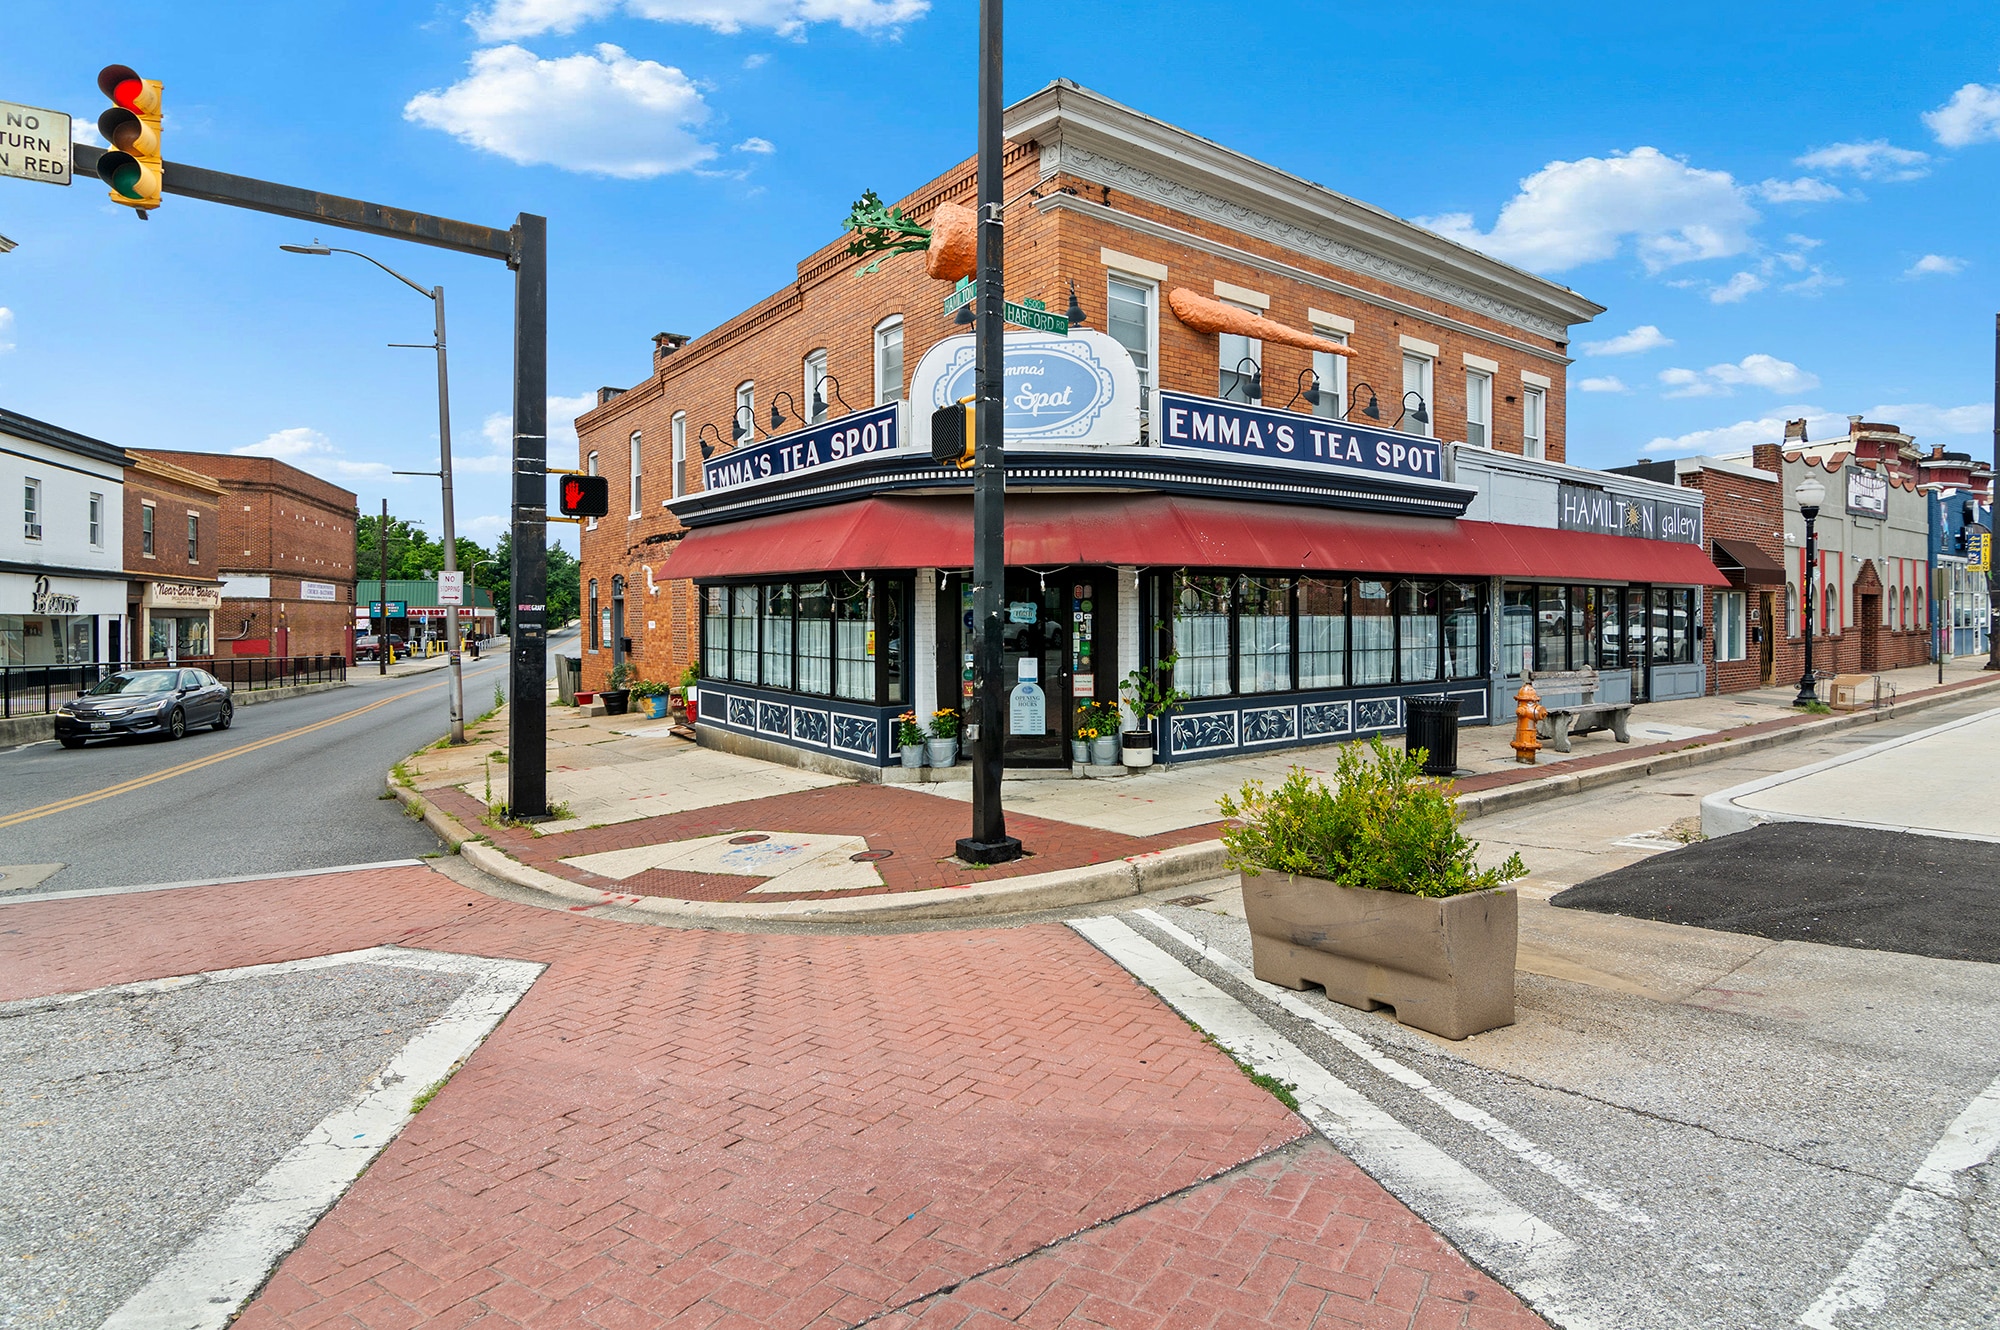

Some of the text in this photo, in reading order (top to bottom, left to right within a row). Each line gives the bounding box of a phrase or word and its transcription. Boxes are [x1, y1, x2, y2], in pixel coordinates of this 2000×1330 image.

[7, 111, 39, 130] NO
[0, 131, 50, 153] TURN
[0, 153, 63, 175] N RED
[944, 284, 975, 313] HAMILTON
[1008, 305, 1054, 331] HARFORD
[1003, 360, 1045, 376] mma's
[1013, 382, 1073, 417] Spot
[708, 418, 893, 490] EMMA'S TEA SPOT
[1168, 407, 1436, 474] EMMA'S TEA SPOT
[1661, 507, 1697, 541] gallery
